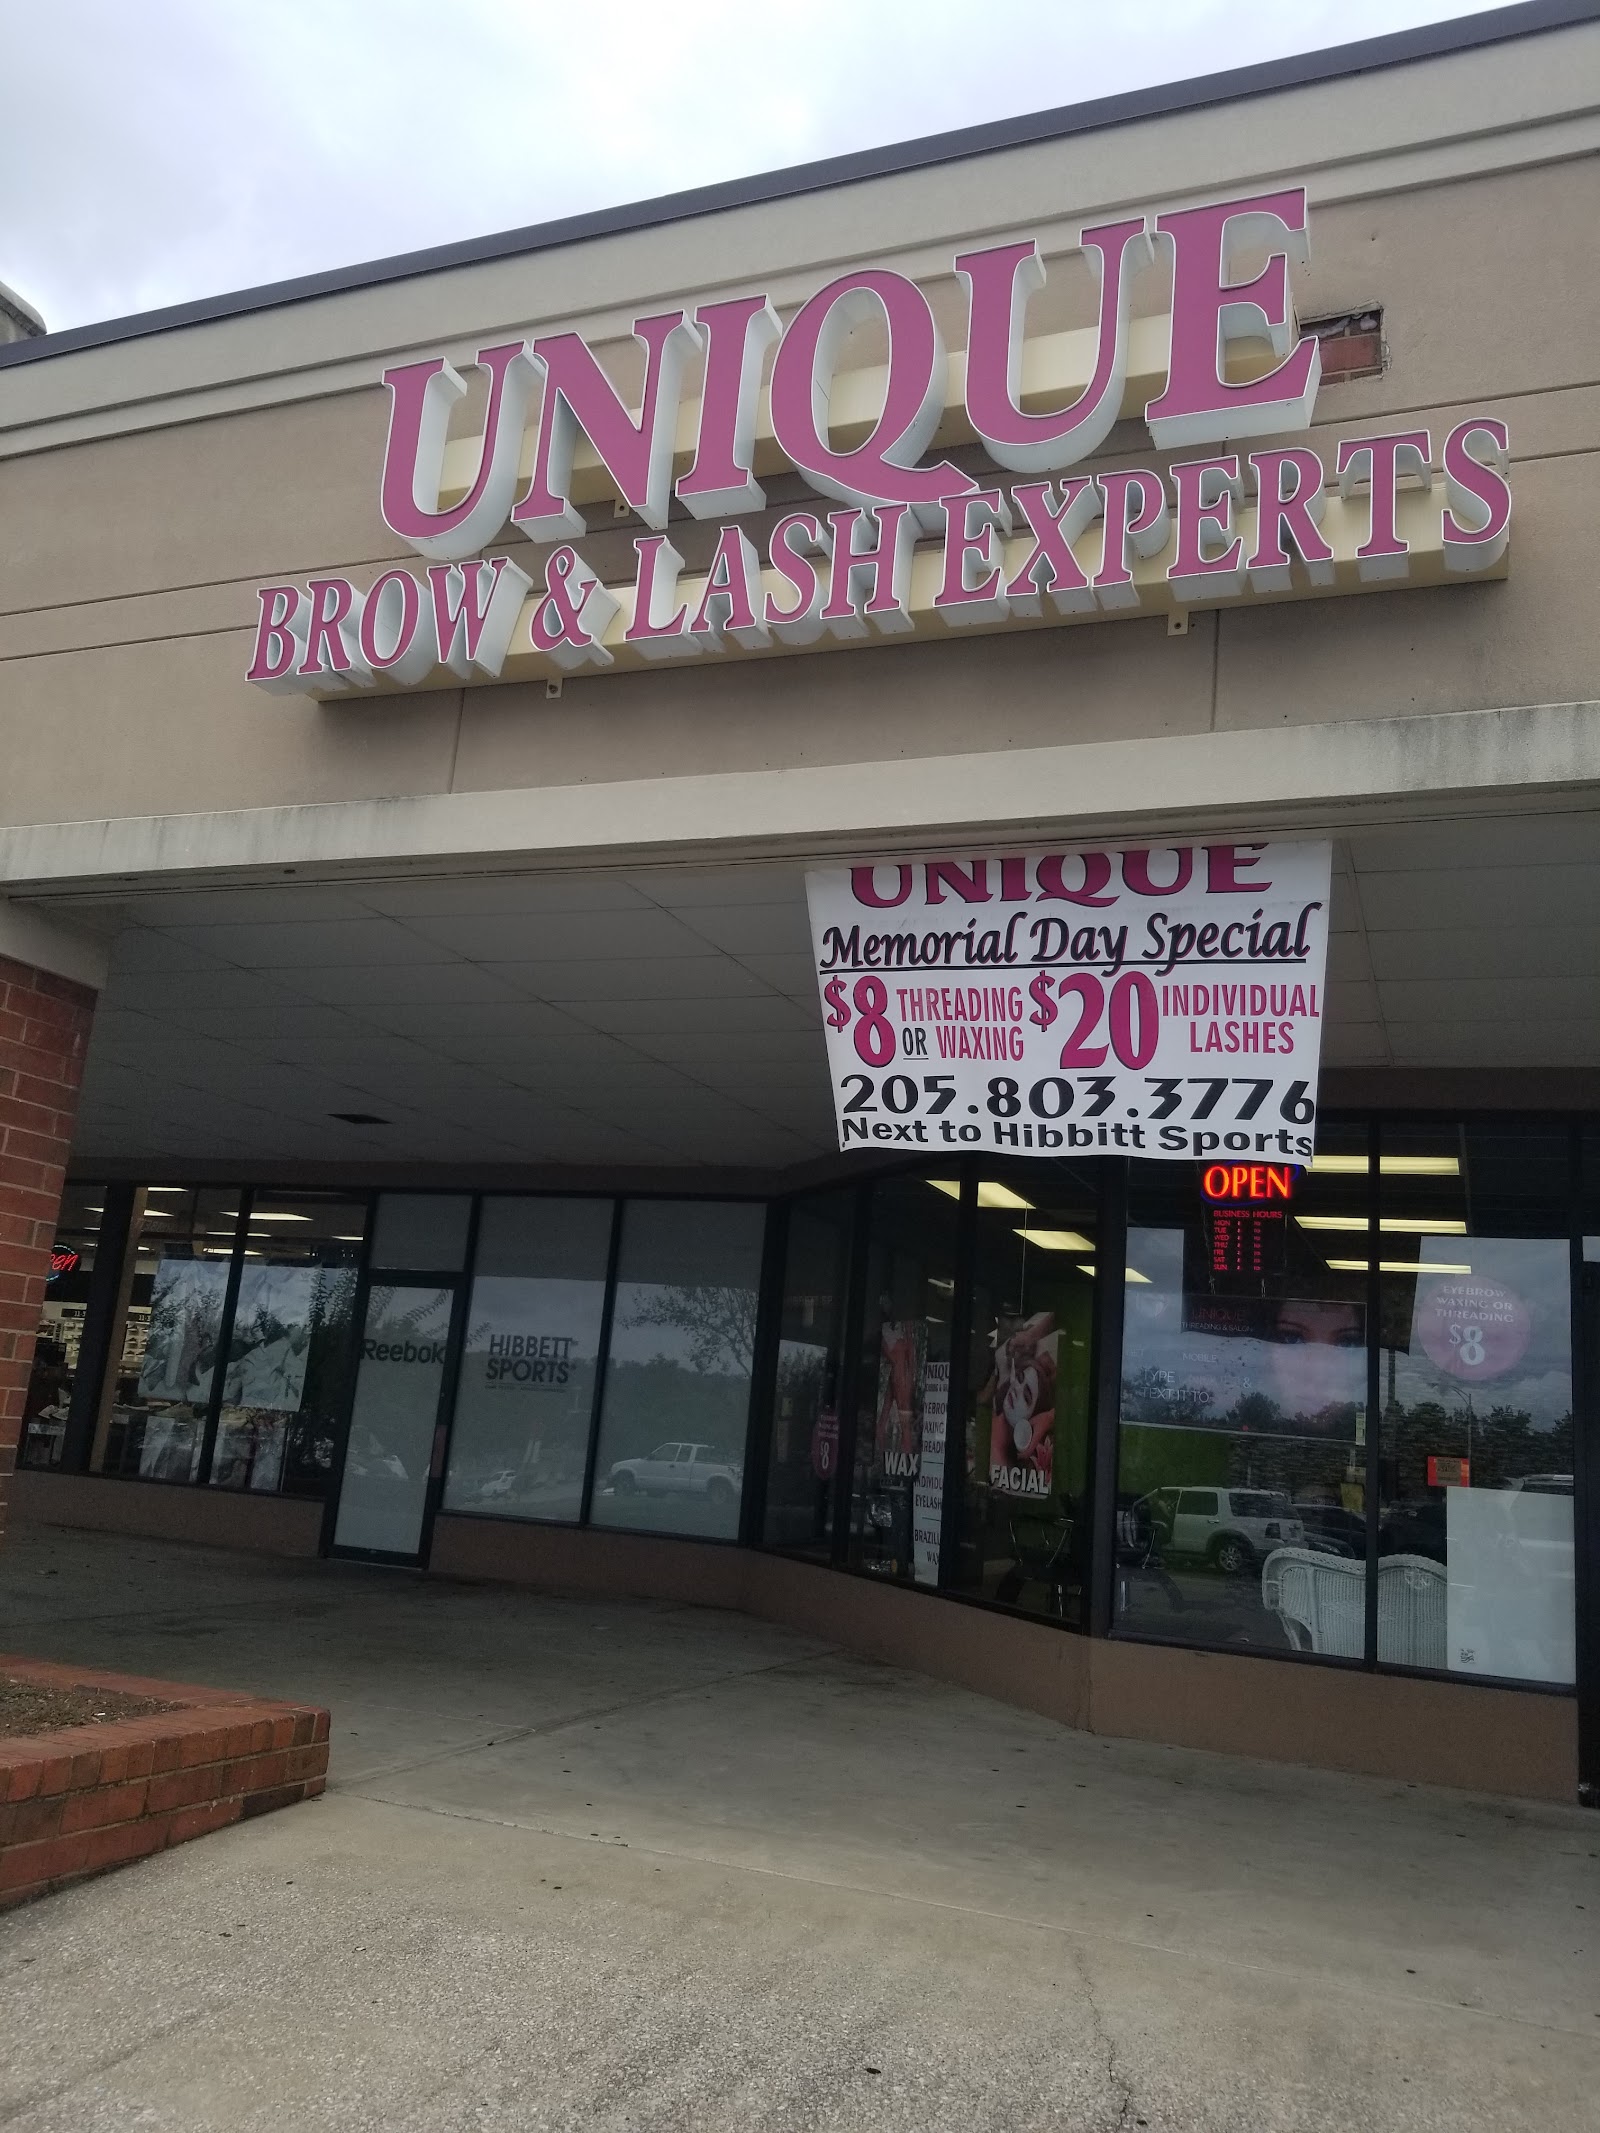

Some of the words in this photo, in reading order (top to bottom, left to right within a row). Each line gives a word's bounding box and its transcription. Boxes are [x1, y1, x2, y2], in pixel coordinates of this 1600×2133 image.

[380, 186, 1321, 540] UNIQUE
[246, 557, 514, 681] BROW
[529, 546, 600, 653] &
[624, 502, 910, 642] LASH
[933, 417, 1513, 609] EXPERTS
[850, 842, 1273, 908] UNIQUE
[819, 911, 1029, 968] Memorial
[1029, 917, 1129, 977] Day
[1141, 901, 1324, 977] Special
[896, 986, 1024, 1023] THREADING
[1162, 983, 1321, 1018] INDIVIDUAL
[824, 975, 897, 1069] $8
[1028, 970, 1160, 1072] $20
[1189, 1020, 1296, 1055] LASHES
[902, 1027, 928, 1057] OR
[935, 1025, 1026, 1062] WAXING
[840, 1074, 1316, 1126] 205.803.3776
[841, 1117, 930, 1143] Next
[938, 1120, 982, 1144] to
[993, 1121, 1147, 1149] Hibbitt
[1158, 1125, 1313, 1158] Sports
[1202, 1164, 1292, 1200] OPEN
[1213, 1210, 1250, 1219] BUSINESS
[1252, 1211, 1283, 1219] HOURS
[1436, 1296, 1489, 1309] WAXING
[1492, 1301, 1513, 1311] OR
[1443, 1285, 1507, 1298] EYEBROW
[1181, 1320, 1222, 1331] THREADING
[1434, 1308, 1514, 1323] THREADING
[360, 1338, 447, 1364] Reebok
[489, 1333, 573, 1359] HIBBETT
[1182, 1352, 1217, 1363] MOBILE
[1448, 1322, 1486, 1366] $8
[485, 1358, 570, 1384] SPORTS
[1143, 1369, 1176, 1384] TYPE
[1242, 1376, 1252, 1389] &
[1140, 1386, 1175, 1400] TEXT
[1191, 1390, 1210, 1403] TO
[884, 1451, 919, 1477] WAX
[991, 1464, 1049, 1495] FACIAL
